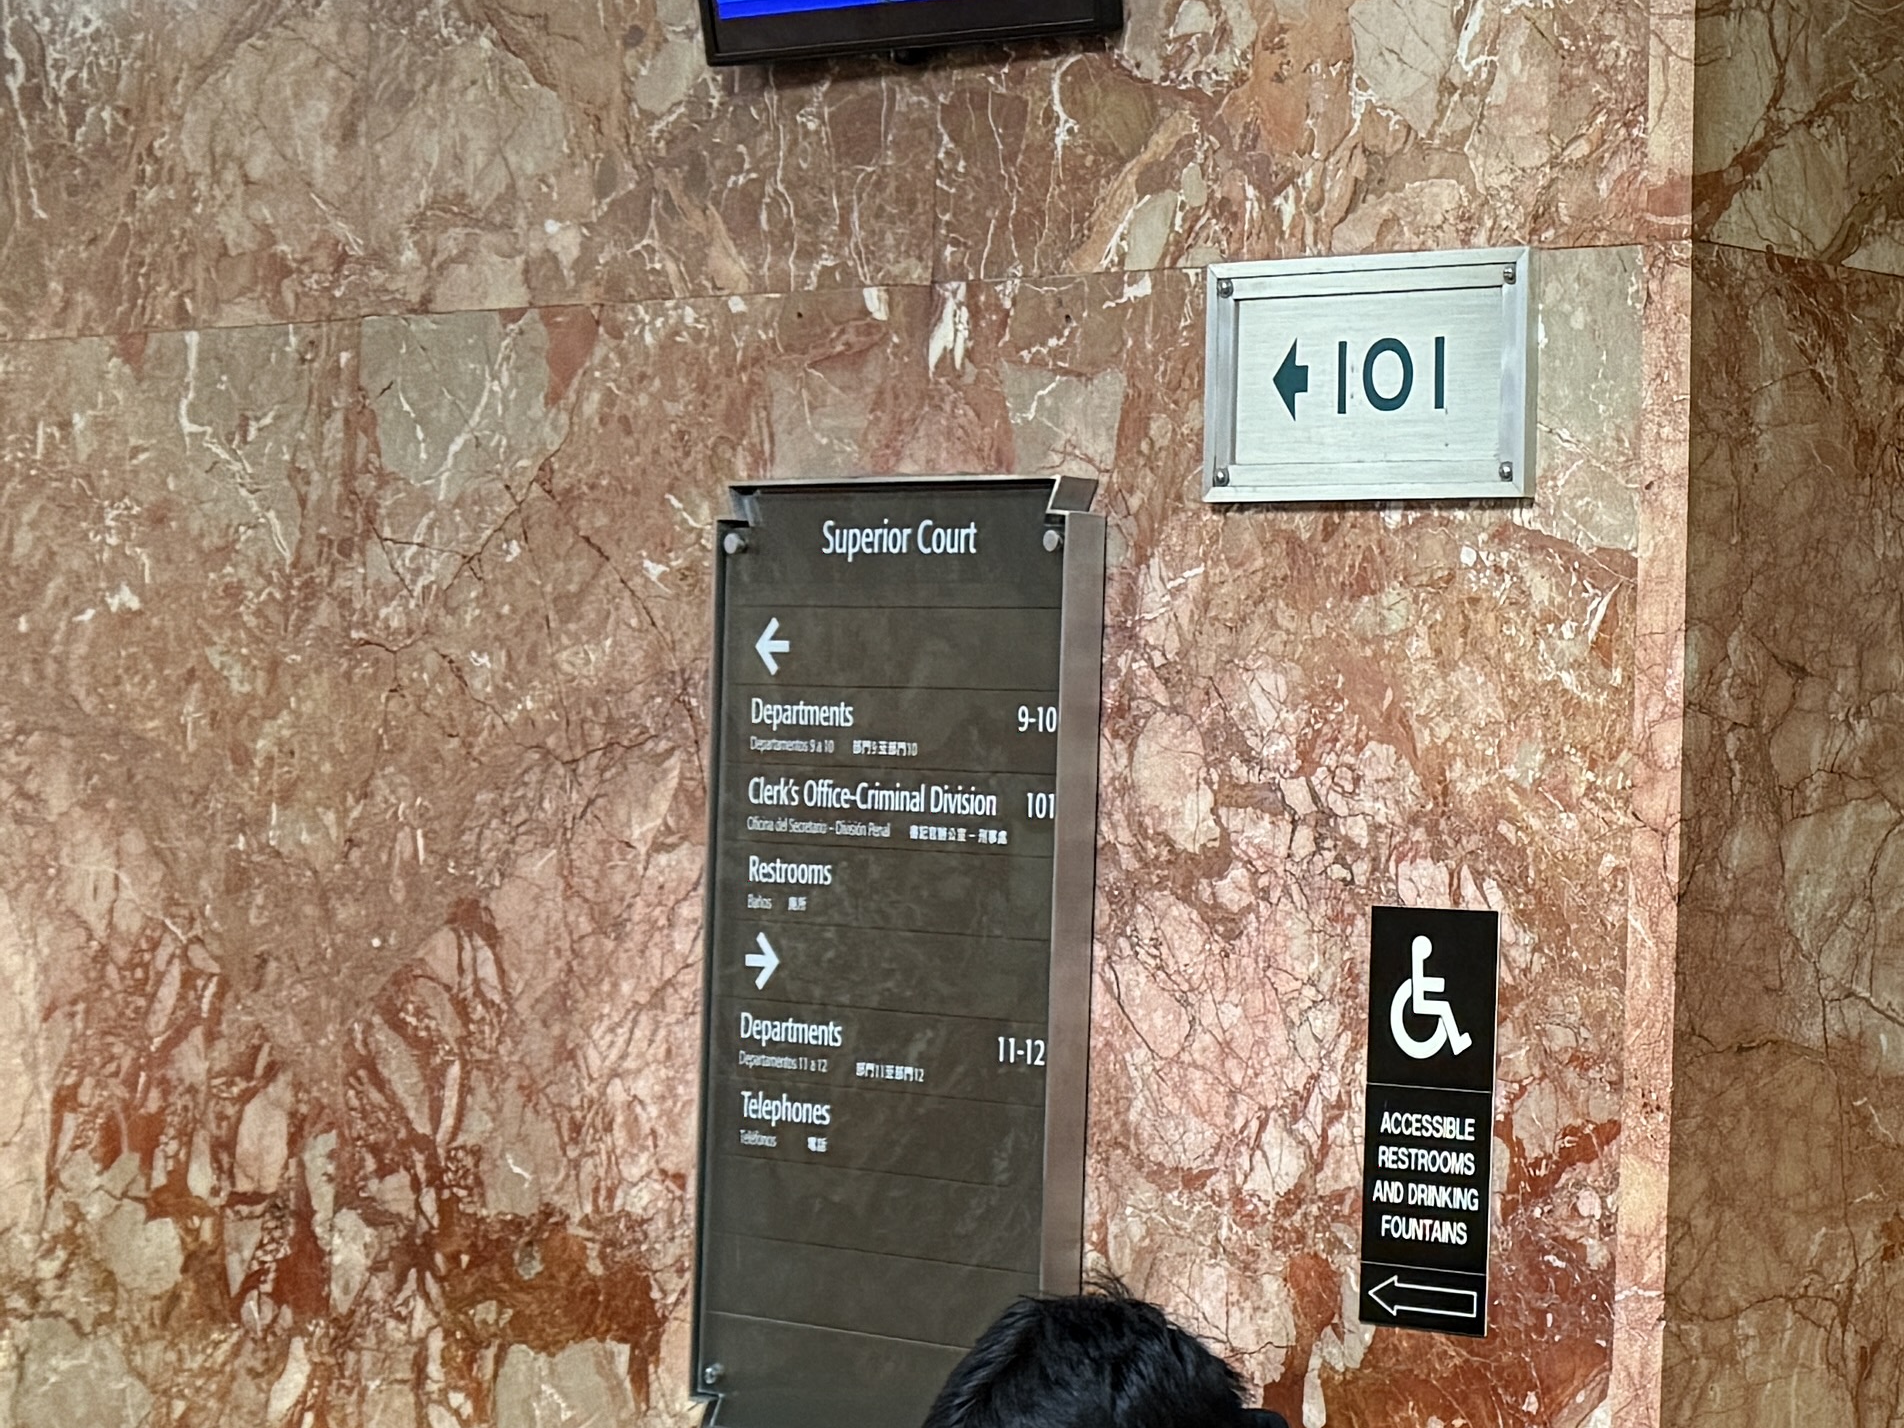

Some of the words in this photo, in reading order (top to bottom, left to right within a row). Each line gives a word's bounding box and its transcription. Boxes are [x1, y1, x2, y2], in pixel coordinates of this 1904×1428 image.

[1337, 336, 1445, 415] 101
[822, 519, 911, 562] Superior
[917, 520, 977, 554] Court
[751, 697, 854, 732] Departments
[1017, 705, 1057, 733] 9-10
[748, 776, 800, 806] Clerk's
[803, 779, 926, 813] Office-Criminal
[930, 784, 997, 816] Division
[1026, 792, 1056, 820] 101
[749, 855, 832, 885] Restrooms
[740, 1011, 843, 1047] Departments
[997, 1035, 1046, 1067] 11-12
[741, 1090, 831, 1127] Telephones
[1380, 1111, 1476, 1142] ACCESSIBLE
[1378, 1145, 1475, 1176] RESTROOMS
[1372, 1179, 1405, 1206] AND
[1407, 1183, 1479, 1211] DRINKING
[1380, 1214, 1468, 1246] FOUNTAINS
